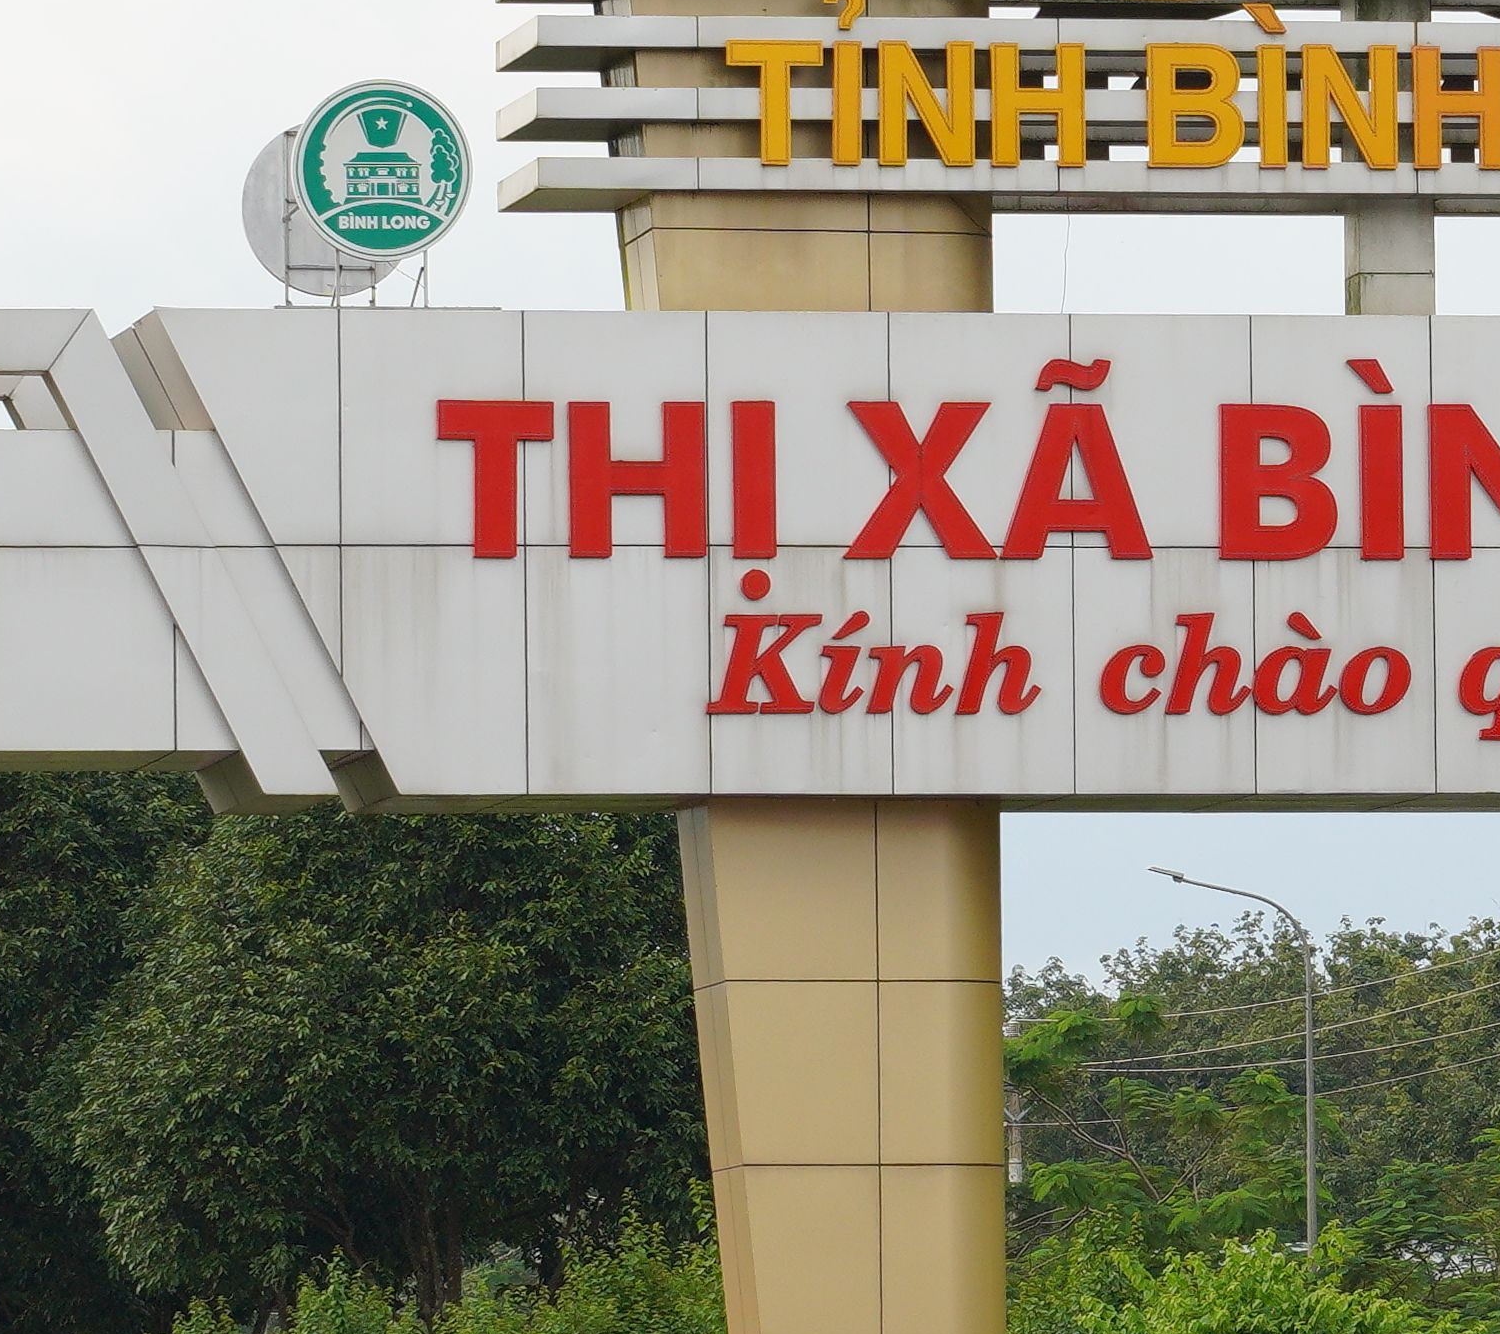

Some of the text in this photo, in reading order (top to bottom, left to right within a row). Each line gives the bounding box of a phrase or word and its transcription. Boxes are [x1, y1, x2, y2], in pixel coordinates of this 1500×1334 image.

[338, 212, 431, 231] BÌNH LONG
[436, 398, 778, 601] THỊ
[845, 358, 1154, 561] XÃ
[707, 610, 1041, 715] Kính
[1100, 612, 1411, 716] chào
